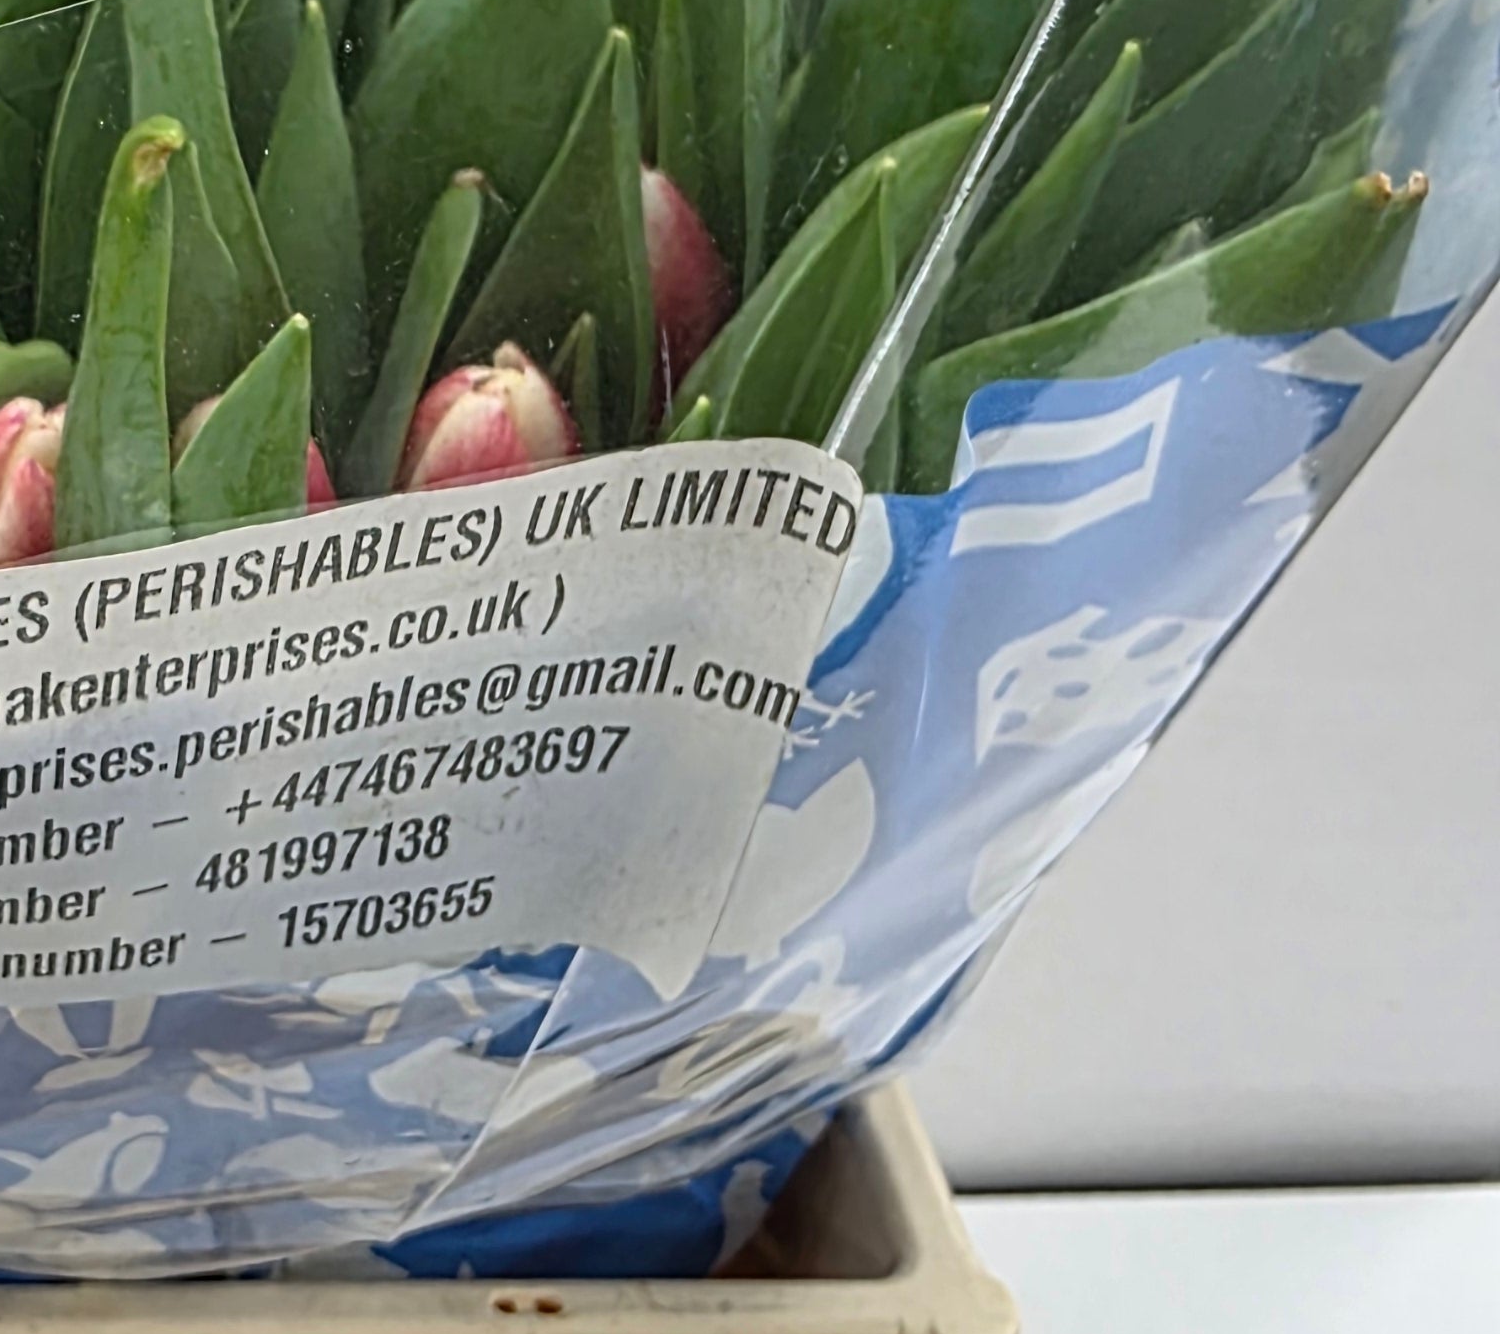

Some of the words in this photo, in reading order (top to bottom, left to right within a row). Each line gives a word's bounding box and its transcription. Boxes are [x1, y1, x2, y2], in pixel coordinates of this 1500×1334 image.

[75, 505, 503, 642] (PERISHABLES)
[526, 481, 606, 545] UK
[621, 467, 858, 557] LIMITED
[194, 814, 452, 896] 481997138
[1, 930, 186, 978] number
[277, 875, 495, 949] 15703655
